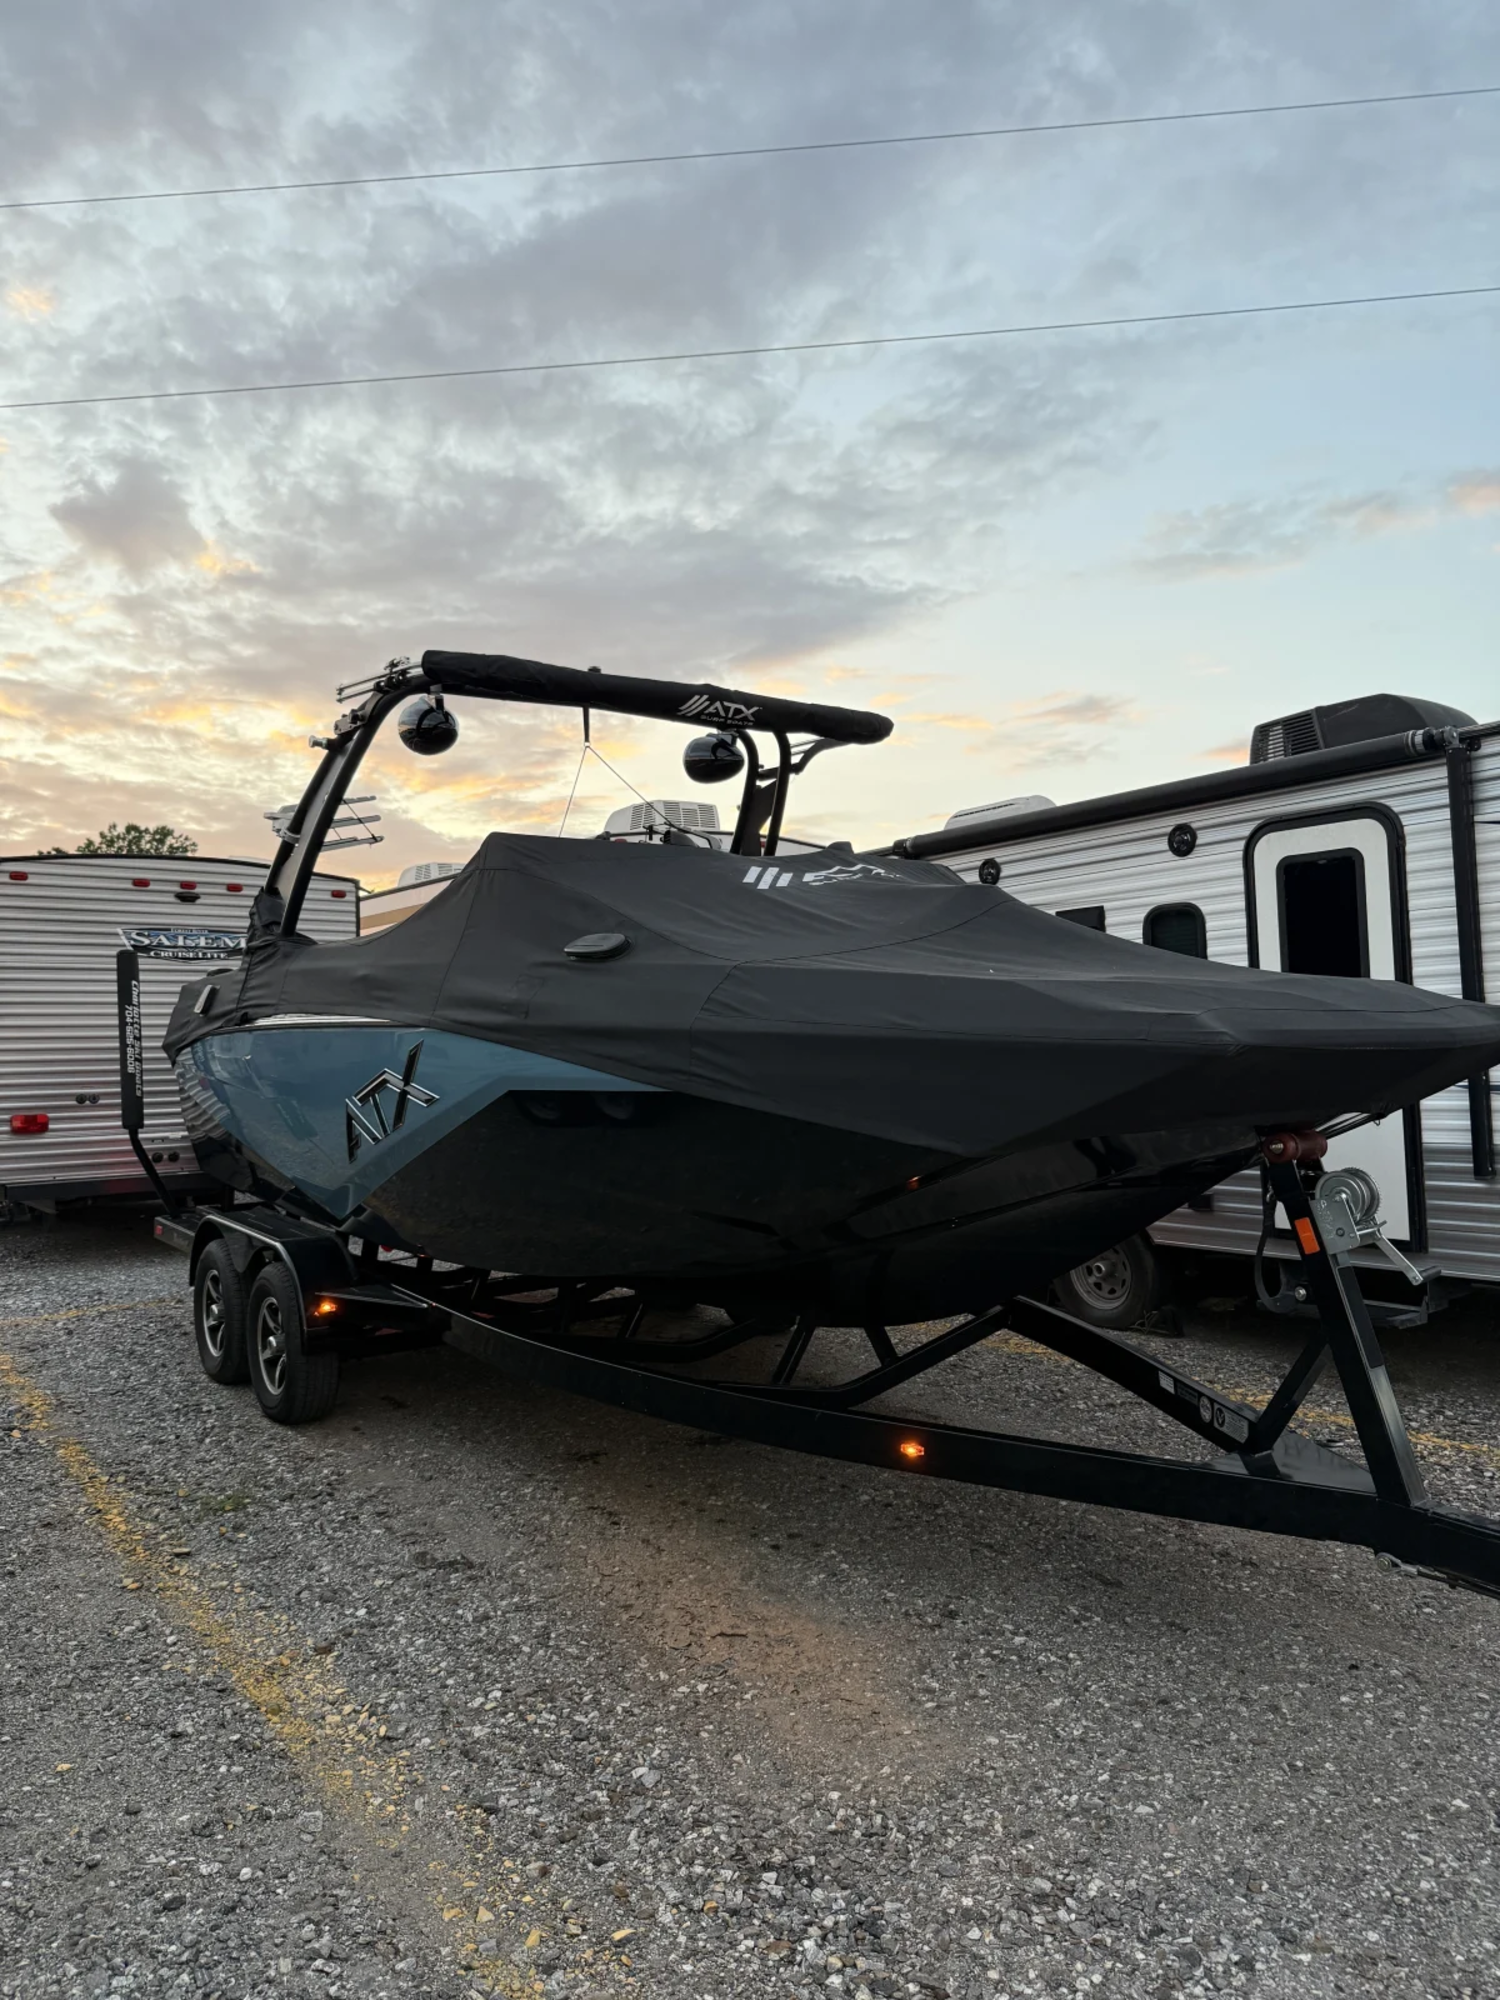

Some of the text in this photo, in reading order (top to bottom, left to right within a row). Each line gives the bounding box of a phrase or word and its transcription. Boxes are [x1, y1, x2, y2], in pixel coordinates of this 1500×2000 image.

[704, 700, 759, 721] ATX
[130, 931, 247, 948] SALEM
[345, 1038, 440, 1164] ATX
